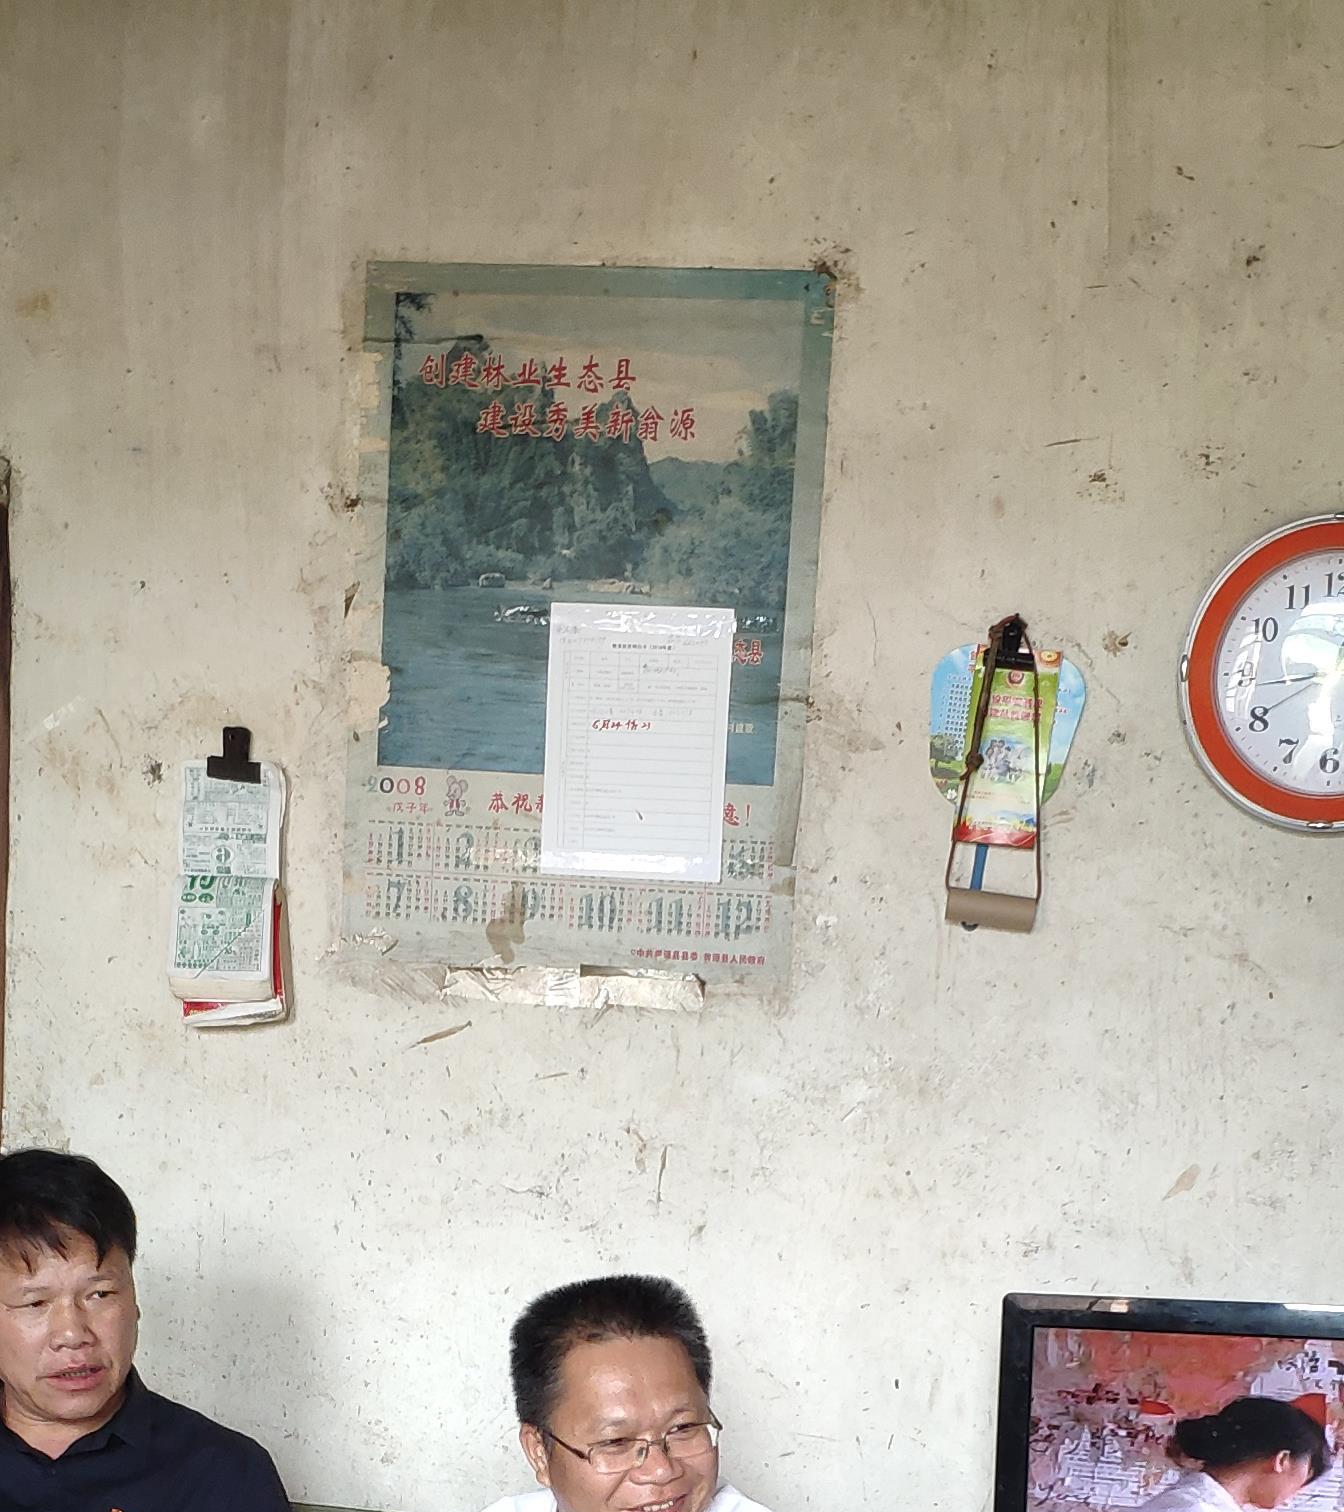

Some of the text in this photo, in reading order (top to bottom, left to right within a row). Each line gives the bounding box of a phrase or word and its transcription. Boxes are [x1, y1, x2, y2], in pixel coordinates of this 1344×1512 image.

[418, 351, 637, 393] 创建林业生态县
[476, 401, 698, 442] 建设秀美新翁源
[1285, 584, 1311, 610] 11
[1252, 617, 1279, 642] 10
[1248, 706, 1270, 732] 8
[1278, 738, 1300, 764] 7
[1319, 748, 1340, 774] 6
[367, 775, 426, 796] 2008
